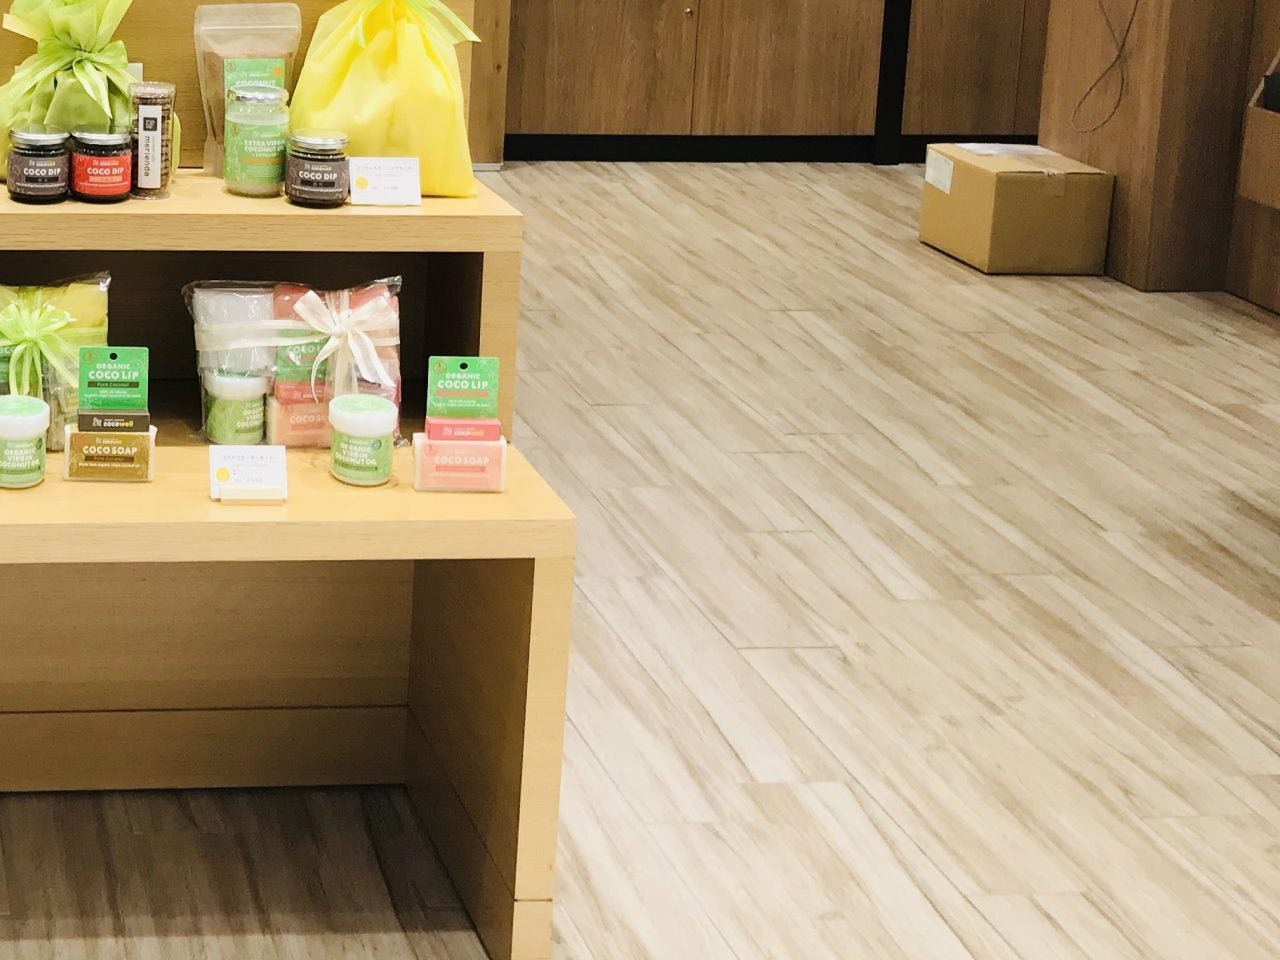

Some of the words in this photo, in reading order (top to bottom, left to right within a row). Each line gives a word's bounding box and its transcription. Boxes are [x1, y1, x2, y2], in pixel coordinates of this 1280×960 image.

[23, 167, 47, 176] COCO
[48, 167, 61, 176] DIP
[86, 167, 111, 176] COCO
[112, 166, 125, 175] DIP
[298, 170, 323, 180] COCO
[323, 172, 338, 180] DIP
[88, 370, 120, 380] COCO
[121, 371, 139, 380] LIP
[437, 380, 469, 389] COCO
[471, 380, 489, 389] LIP
[103, 420, 134, 428] cocowell
[82, 445, 110, 454] COCO
[111, 446, 138, 455] SOAP
[434, 455, 462, 464] COCO
[463, 456, 490, 464] SOAP
